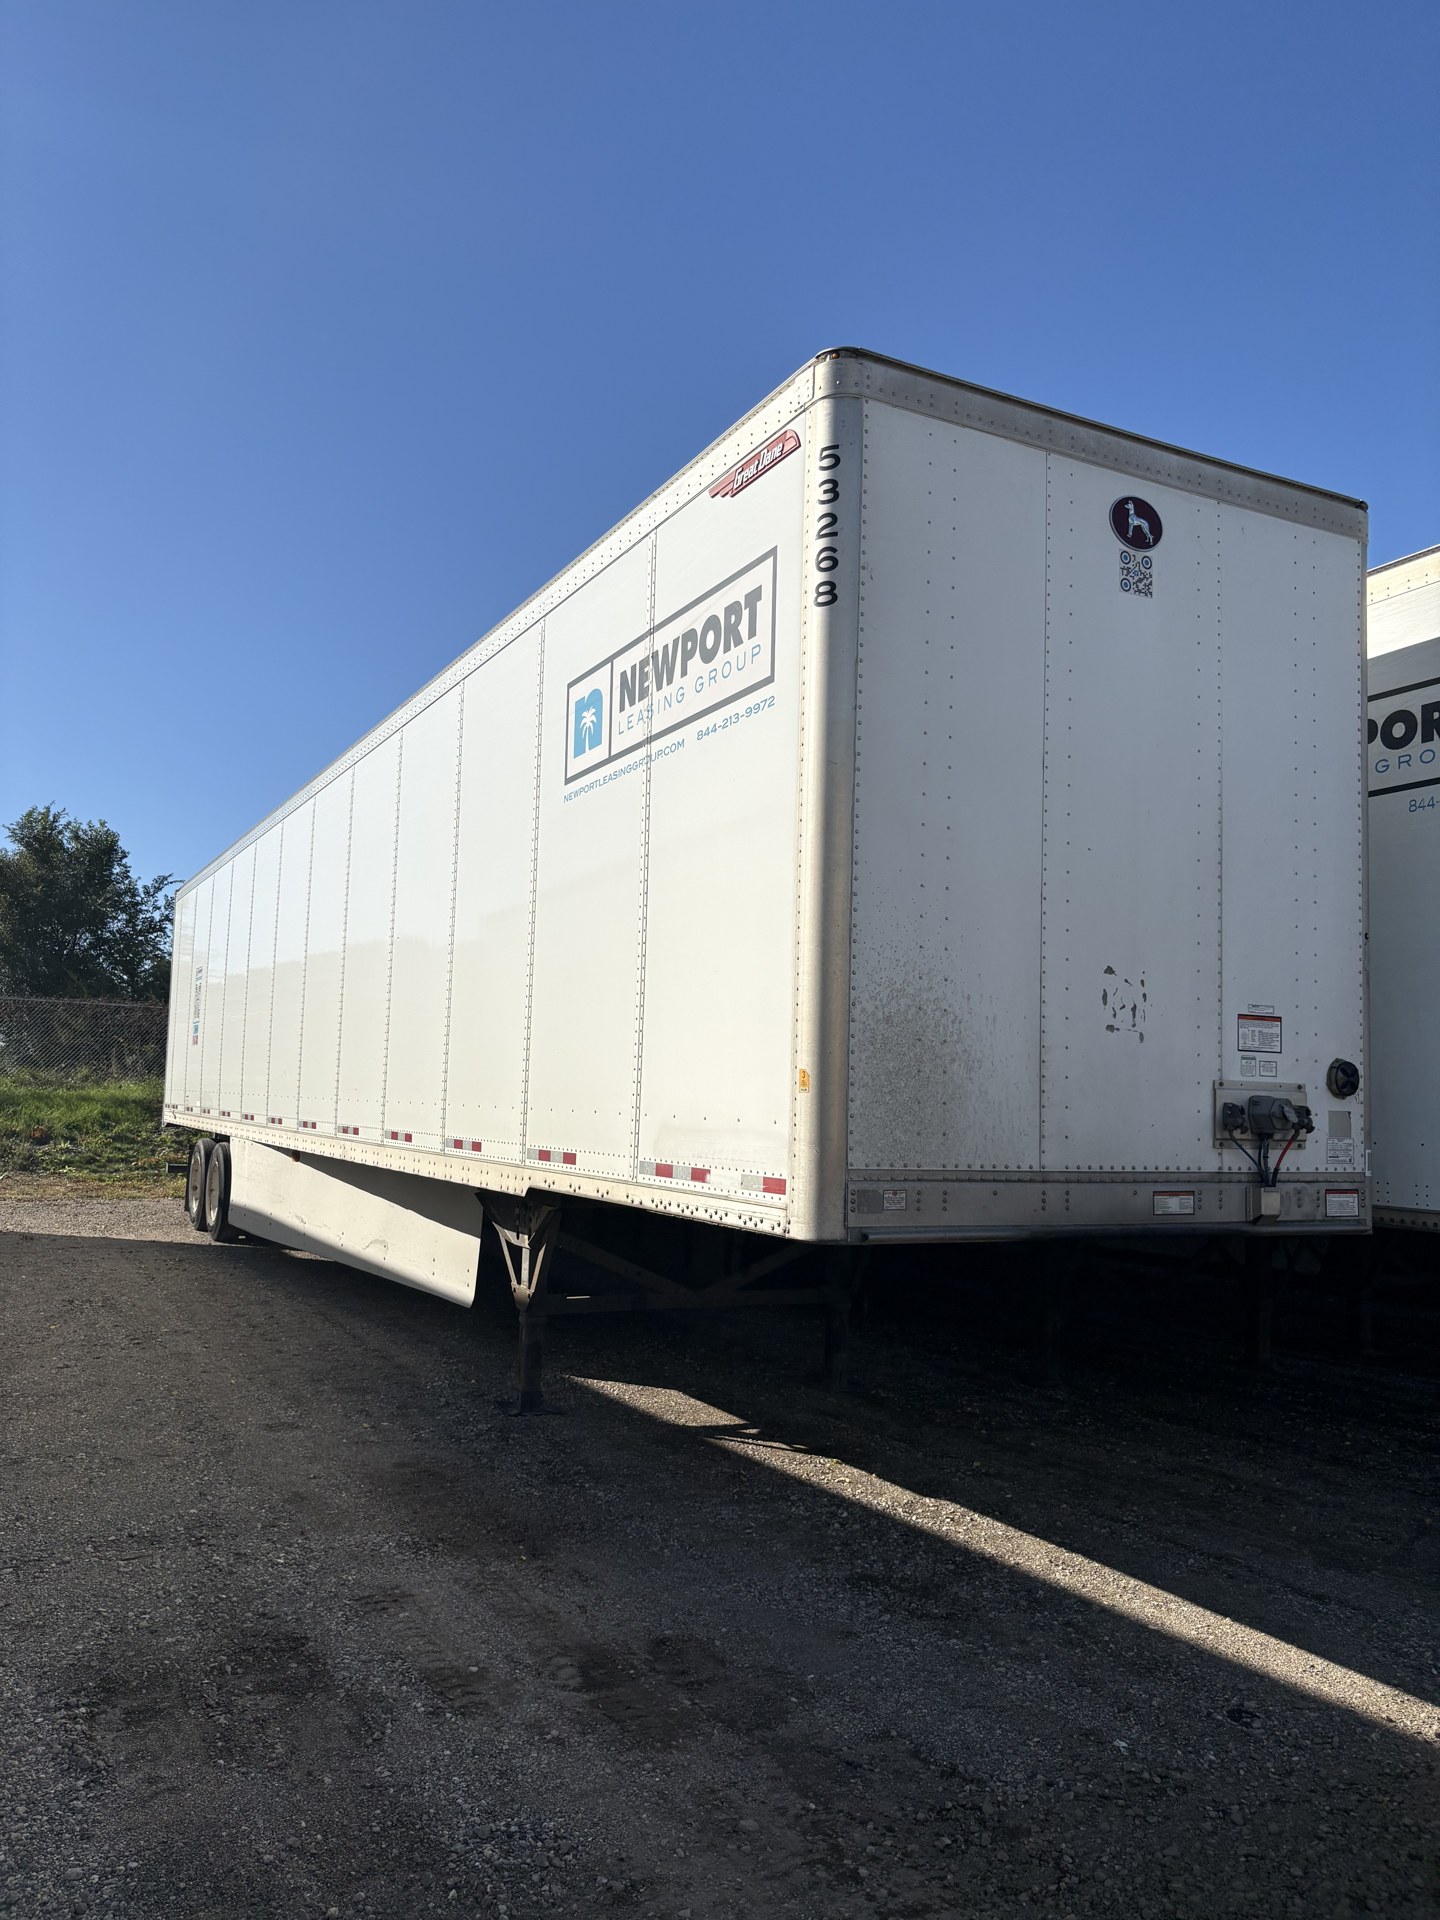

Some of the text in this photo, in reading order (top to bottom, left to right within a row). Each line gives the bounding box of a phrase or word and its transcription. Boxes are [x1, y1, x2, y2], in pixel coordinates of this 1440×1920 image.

[733, 442, 783, 490] Great Dane
[814, 444, 841, 607] 53268
[618, 643, 762, 735] LEASING GROUP
[619, 584, 763, 713] NEWPORT
[563, 695, 776, 803] NEWPORTLEASINGGROUP.COM 844-213-9972
